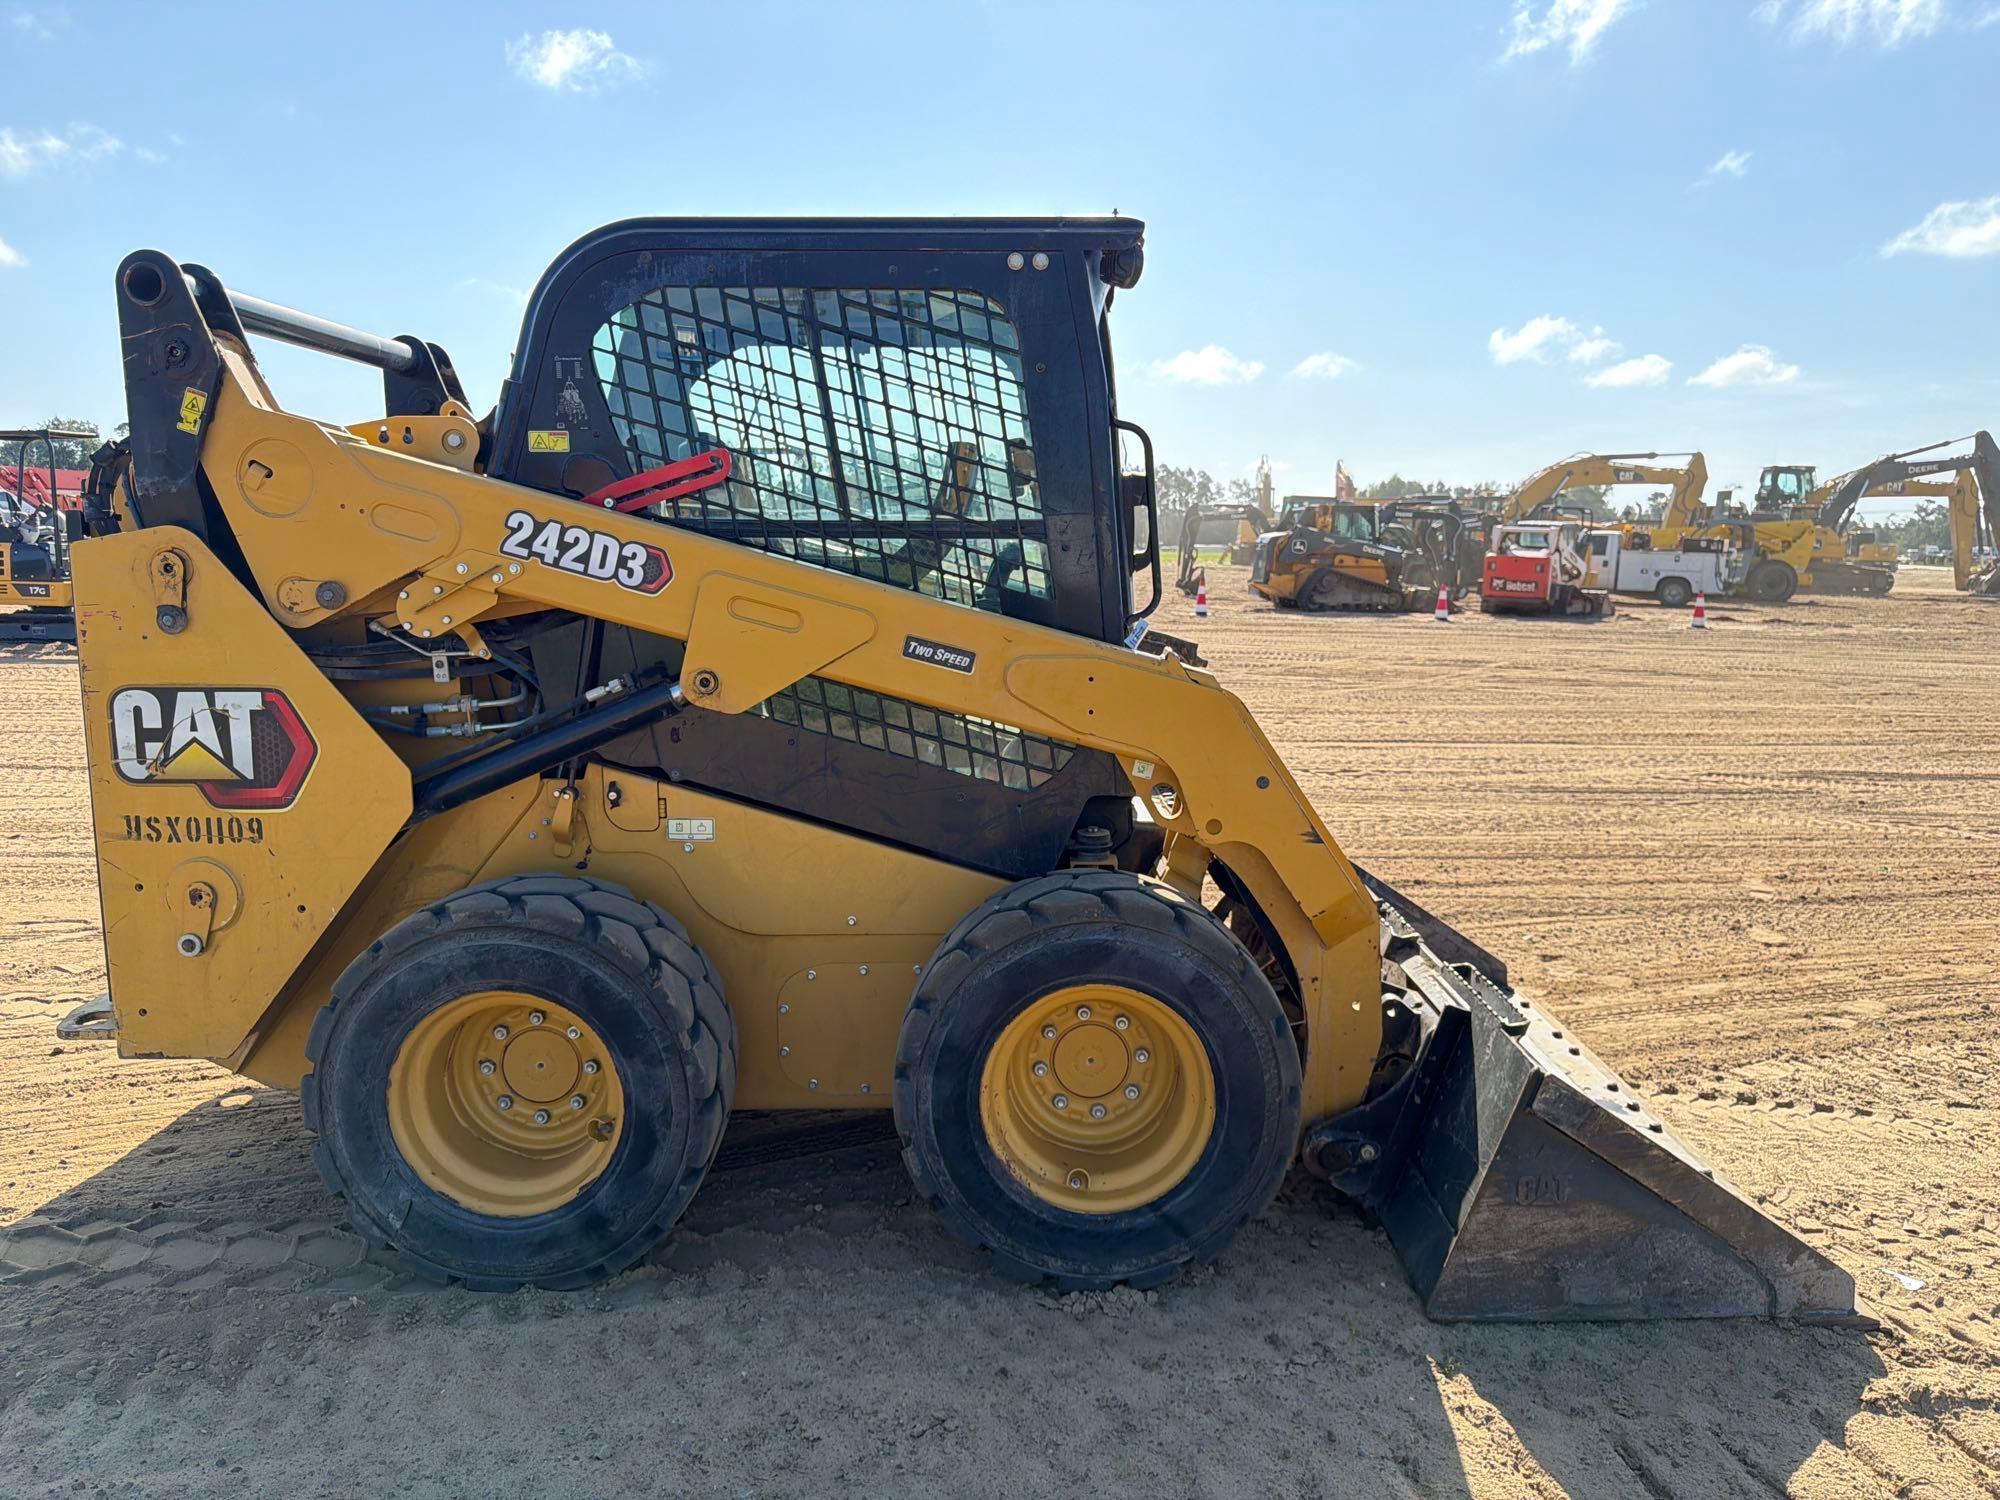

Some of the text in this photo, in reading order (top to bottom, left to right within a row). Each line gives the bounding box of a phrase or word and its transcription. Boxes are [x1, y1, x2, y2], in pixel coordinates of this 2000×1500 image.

[1908, 464, 1939, 474] DEERE
[1619, 471, 1634, 481] CAT
[1887, 482, 1903, 492] CAT
[502, 512, 648, 587] 242D3
[29, 586, 46, 595] 17G
[1506, 580, 1536, 592] Bobcat
[113, 689, 263, 780] CAT
